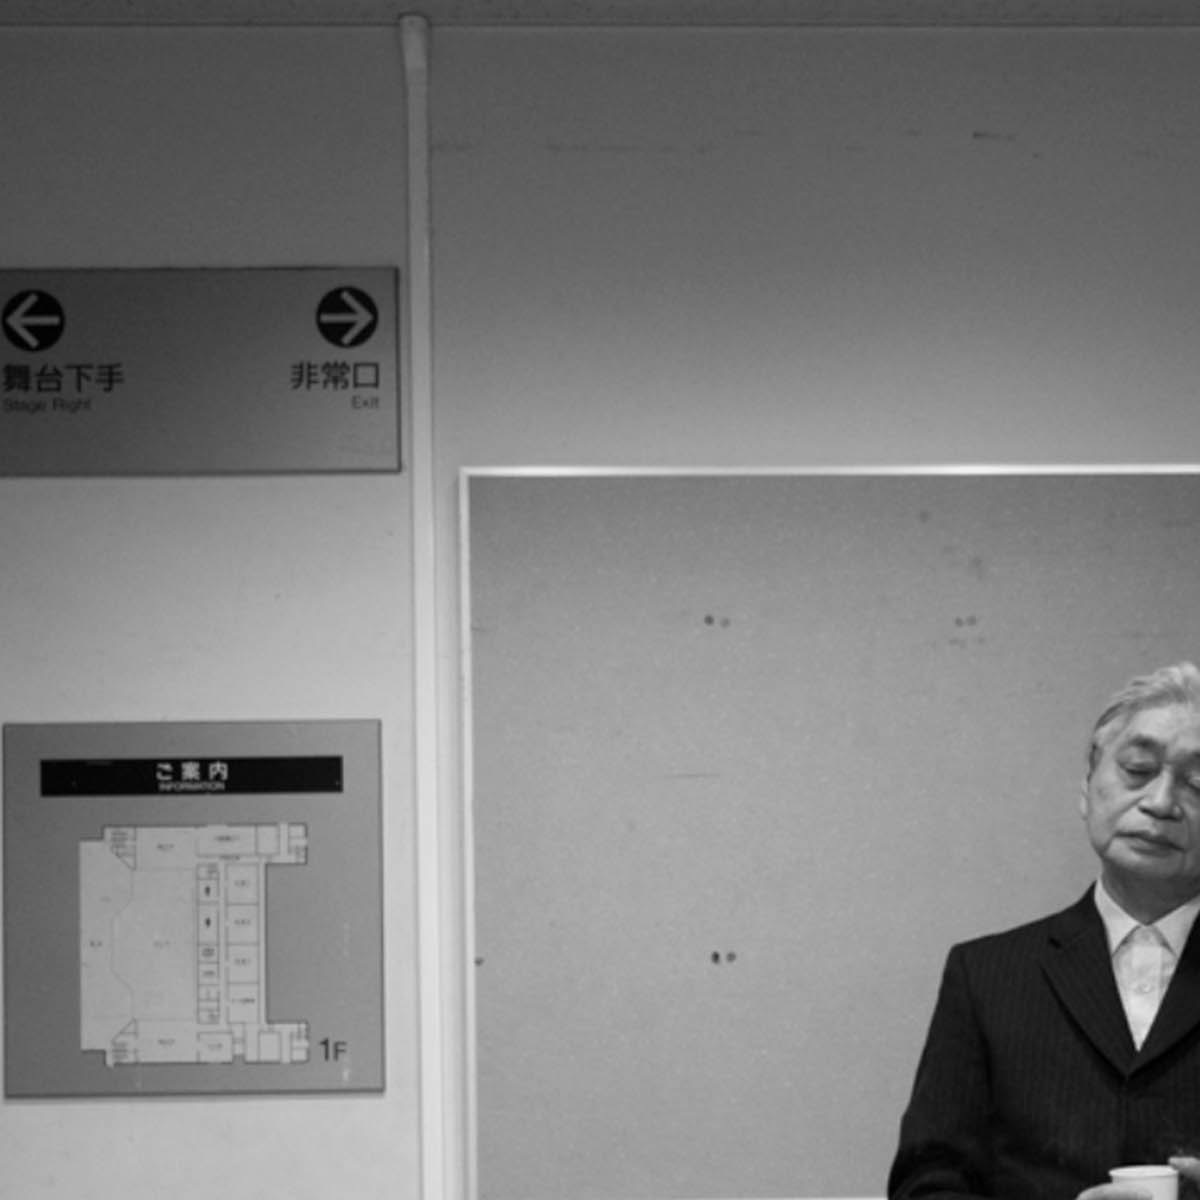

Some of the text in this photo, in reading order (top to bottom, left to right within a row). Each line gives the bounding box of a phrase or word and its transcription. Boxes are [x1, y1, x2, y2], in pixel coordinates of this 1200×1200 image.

[2, 362, 125, 393] 舞台下手
[290, 360, 380, 391] 非常口
[52, 397, 91, 414] Right
[351, 395, 379, 409] Exit
[155, 761, 229, 781] ご案内
[319, 1037, 348, 1062] 1F
